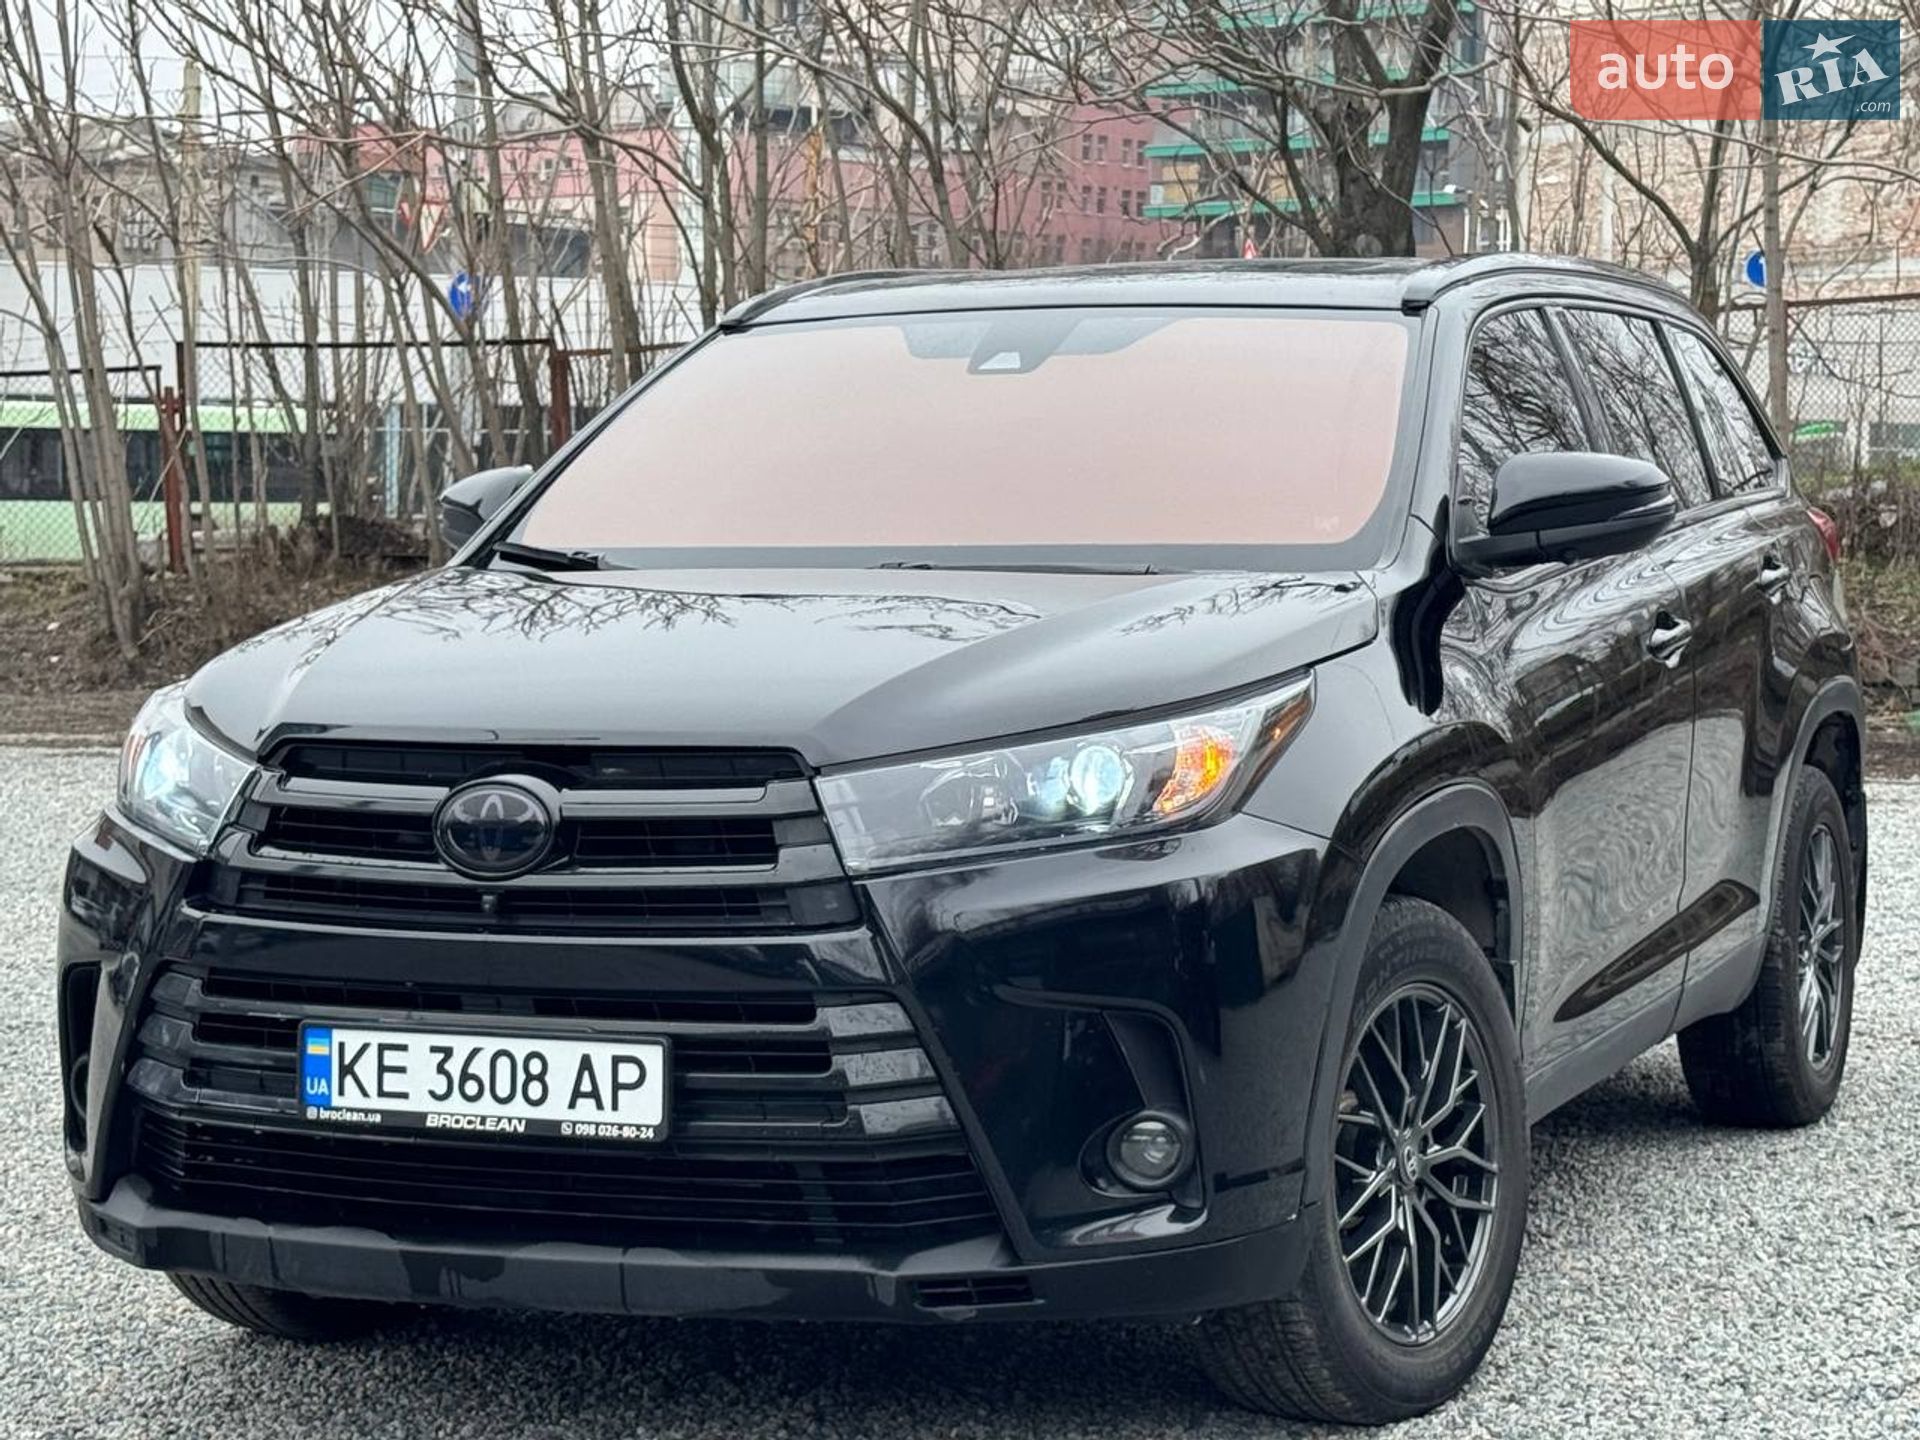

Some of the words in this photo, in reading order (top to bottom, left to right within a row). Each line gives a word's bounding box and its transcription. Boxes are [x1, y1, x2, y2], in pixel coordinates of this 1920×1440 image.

[338, 1041, 409, 1099] KE
[427, 1045, 549, 1107] 3608
[567, 1053, 646, 1112] AP
[306, 1077, 329, 1096] UA
[319, 1106, 382, 1123] broclean.ua
[425, 1113, 527, 1133] BROCLEAN
[575, 1123, 597, 1136] 098
